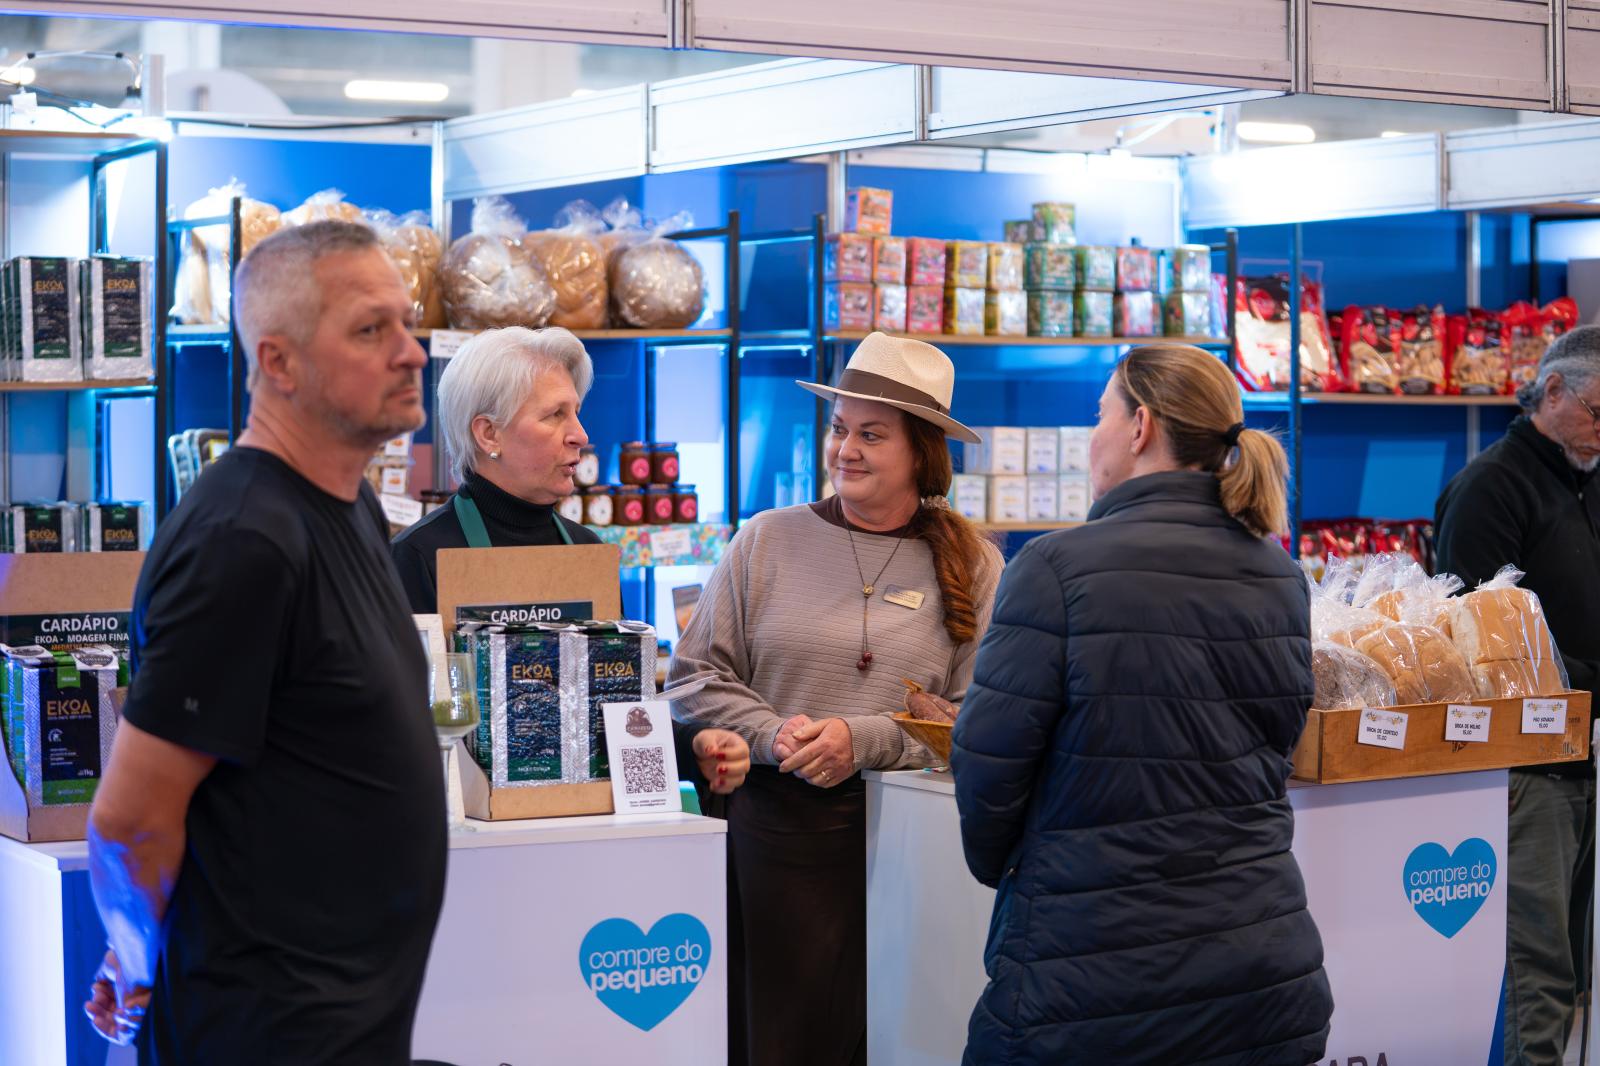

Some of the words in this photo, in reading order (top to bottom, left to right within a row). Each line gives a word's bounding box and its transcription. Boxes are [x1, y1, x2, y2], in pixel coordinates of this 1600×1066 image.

[41, 614, 118, 632] CARDÁPIO
[491, 605, 561, 623] CARDÁPIO
[35, 635, 59, 644] EKOA
[67, 634, 107, 643] MOAGEM
[108, 632, 130, 642] FINA
[511, 663, 553, 679] EKOA
[594, 661, 635, 678] EKOA
[46, 698, 92, 716] EKOA
[1410, 865, 1467, 888] compre
[1471, 860, 1490, 879] do
[1410, 880, 1491, 907] pequeno
[589, 945, 670, 971] compre
[675, 939, 703, 962] do
[590, 962, 703, 994] pequeno
